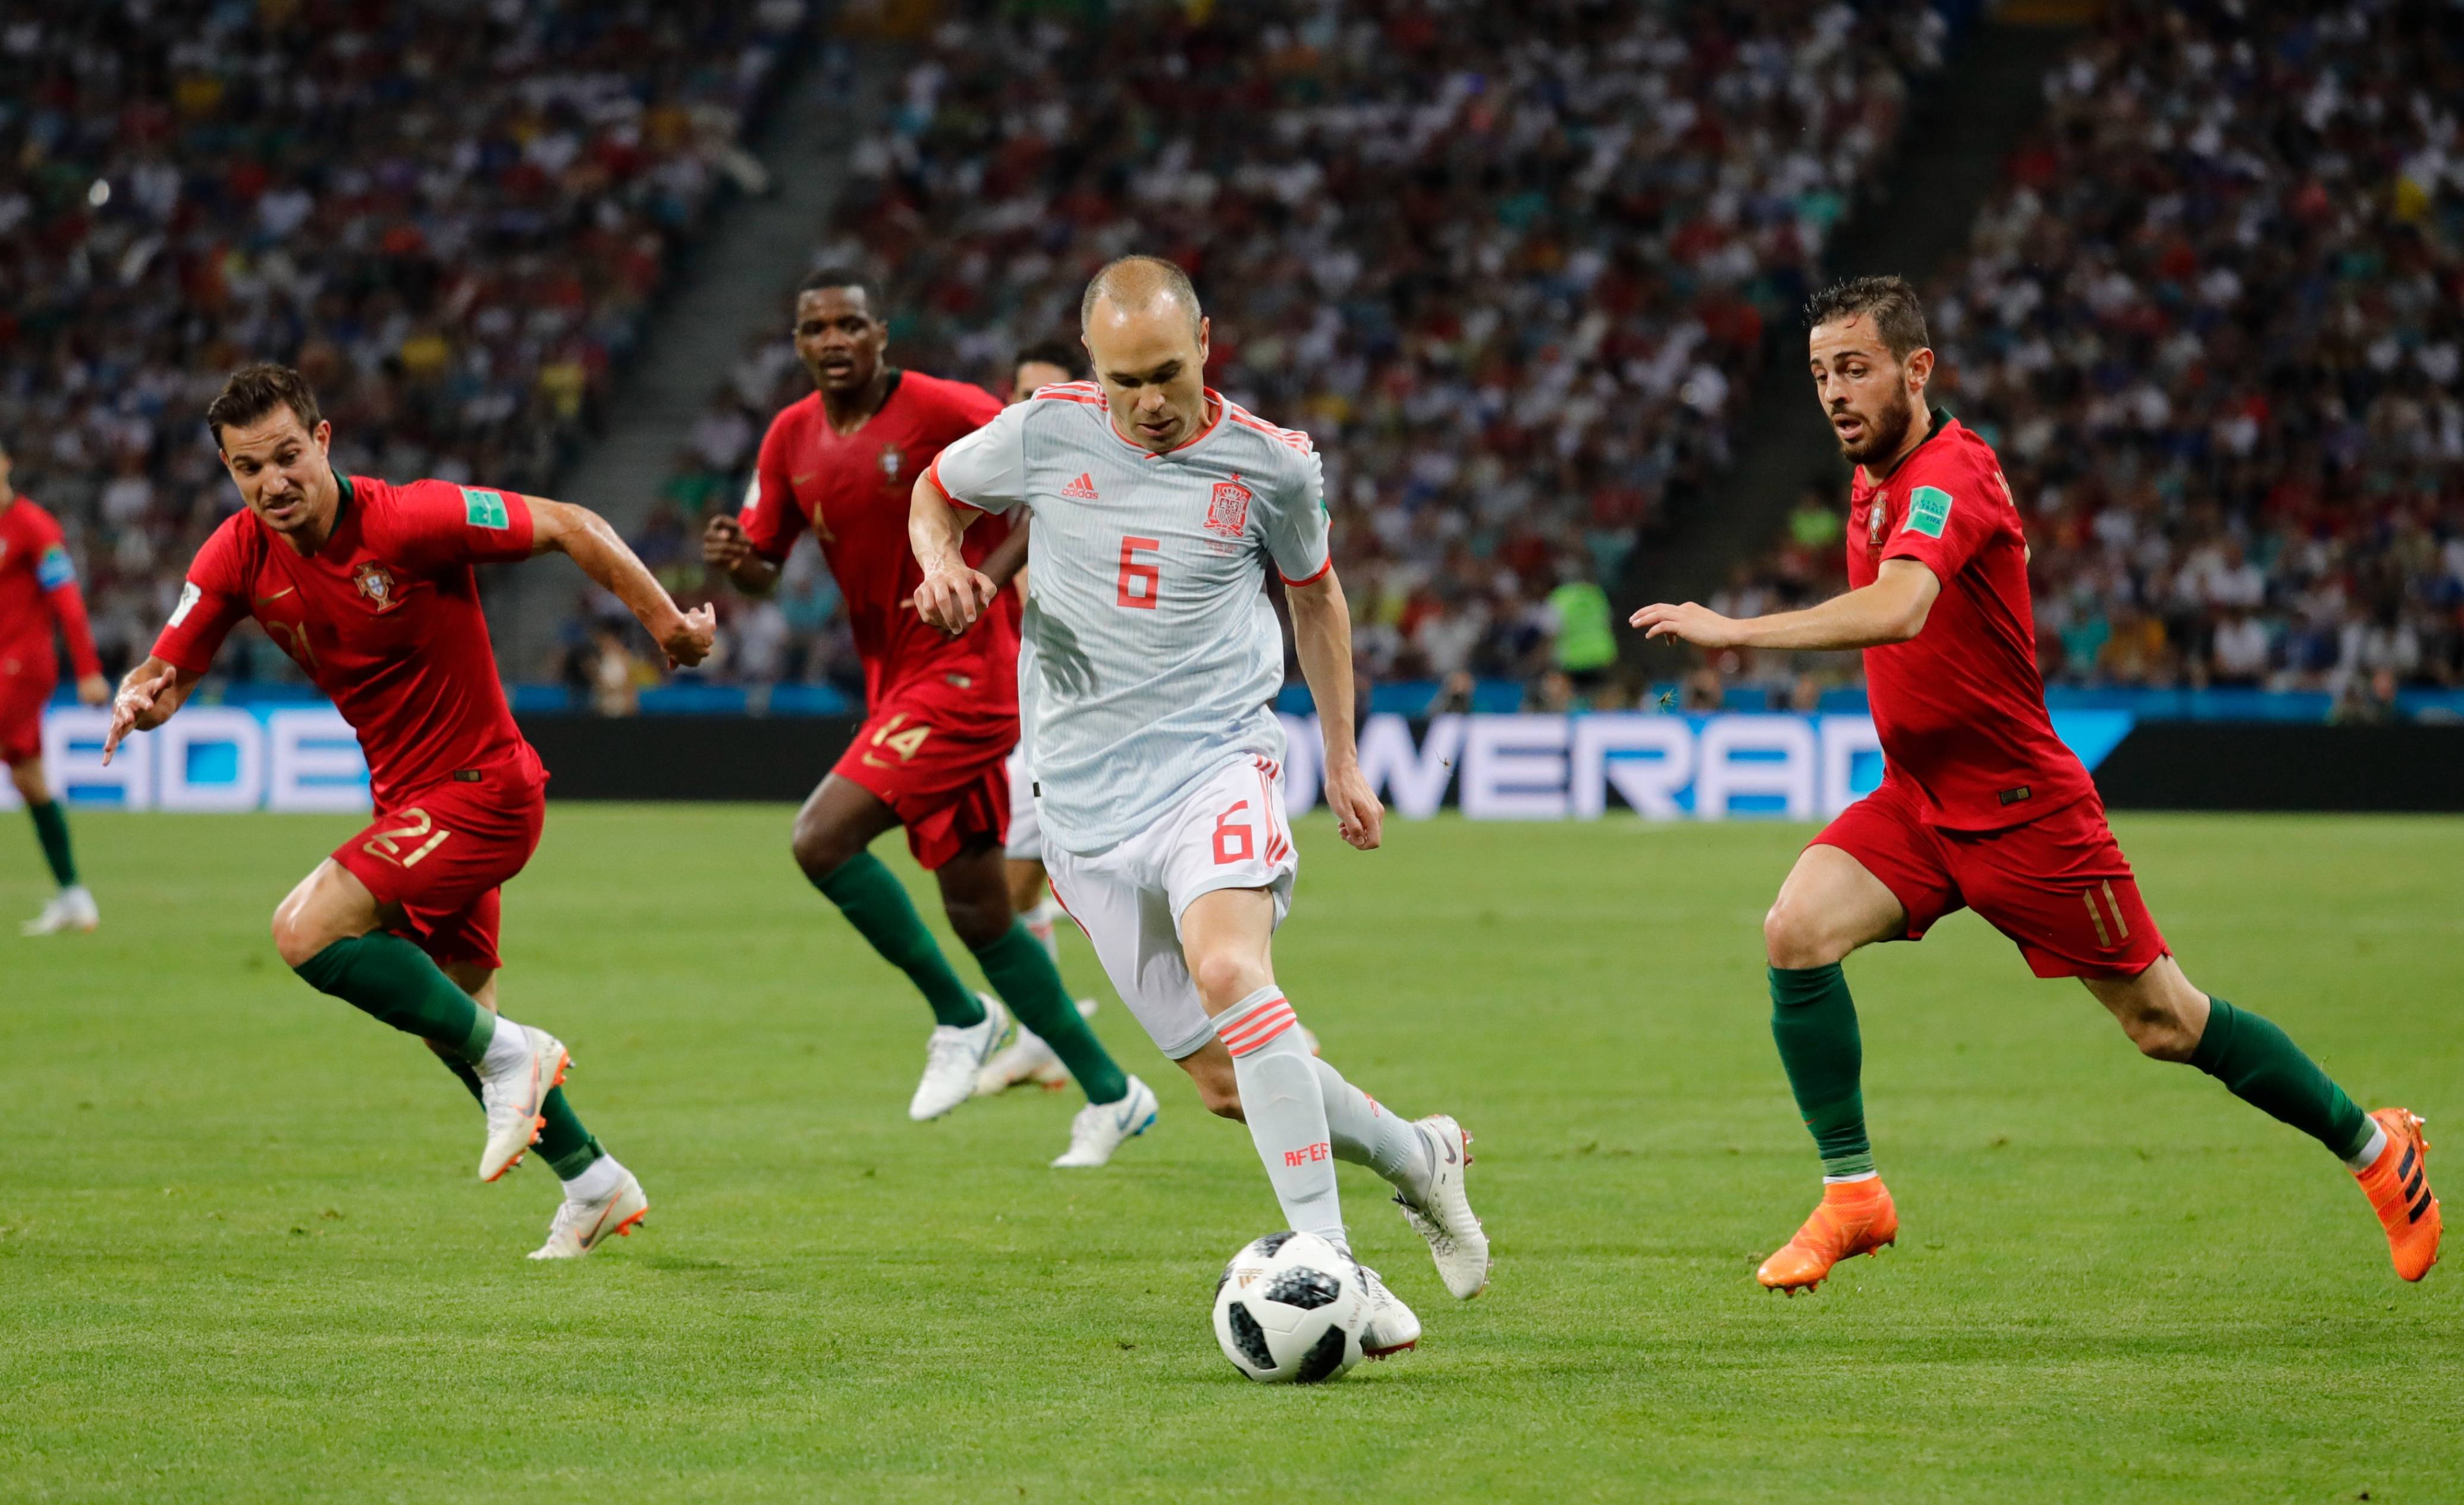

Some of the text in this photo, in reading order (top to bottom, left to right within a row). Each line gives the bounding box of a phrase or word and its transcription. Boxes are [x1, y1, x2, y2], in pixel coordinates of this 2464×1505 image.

[1062, 488, 1099, 499] adidas
[1117, 535, 1160, 610] 6
[0, 708, 375, 813] ADE
[871, 712, 932, 762] 14
[371, 807, 451, 869] 21
[1213, 799, 1254, 865] 6
[2083, 879, 2129, 948] 11
